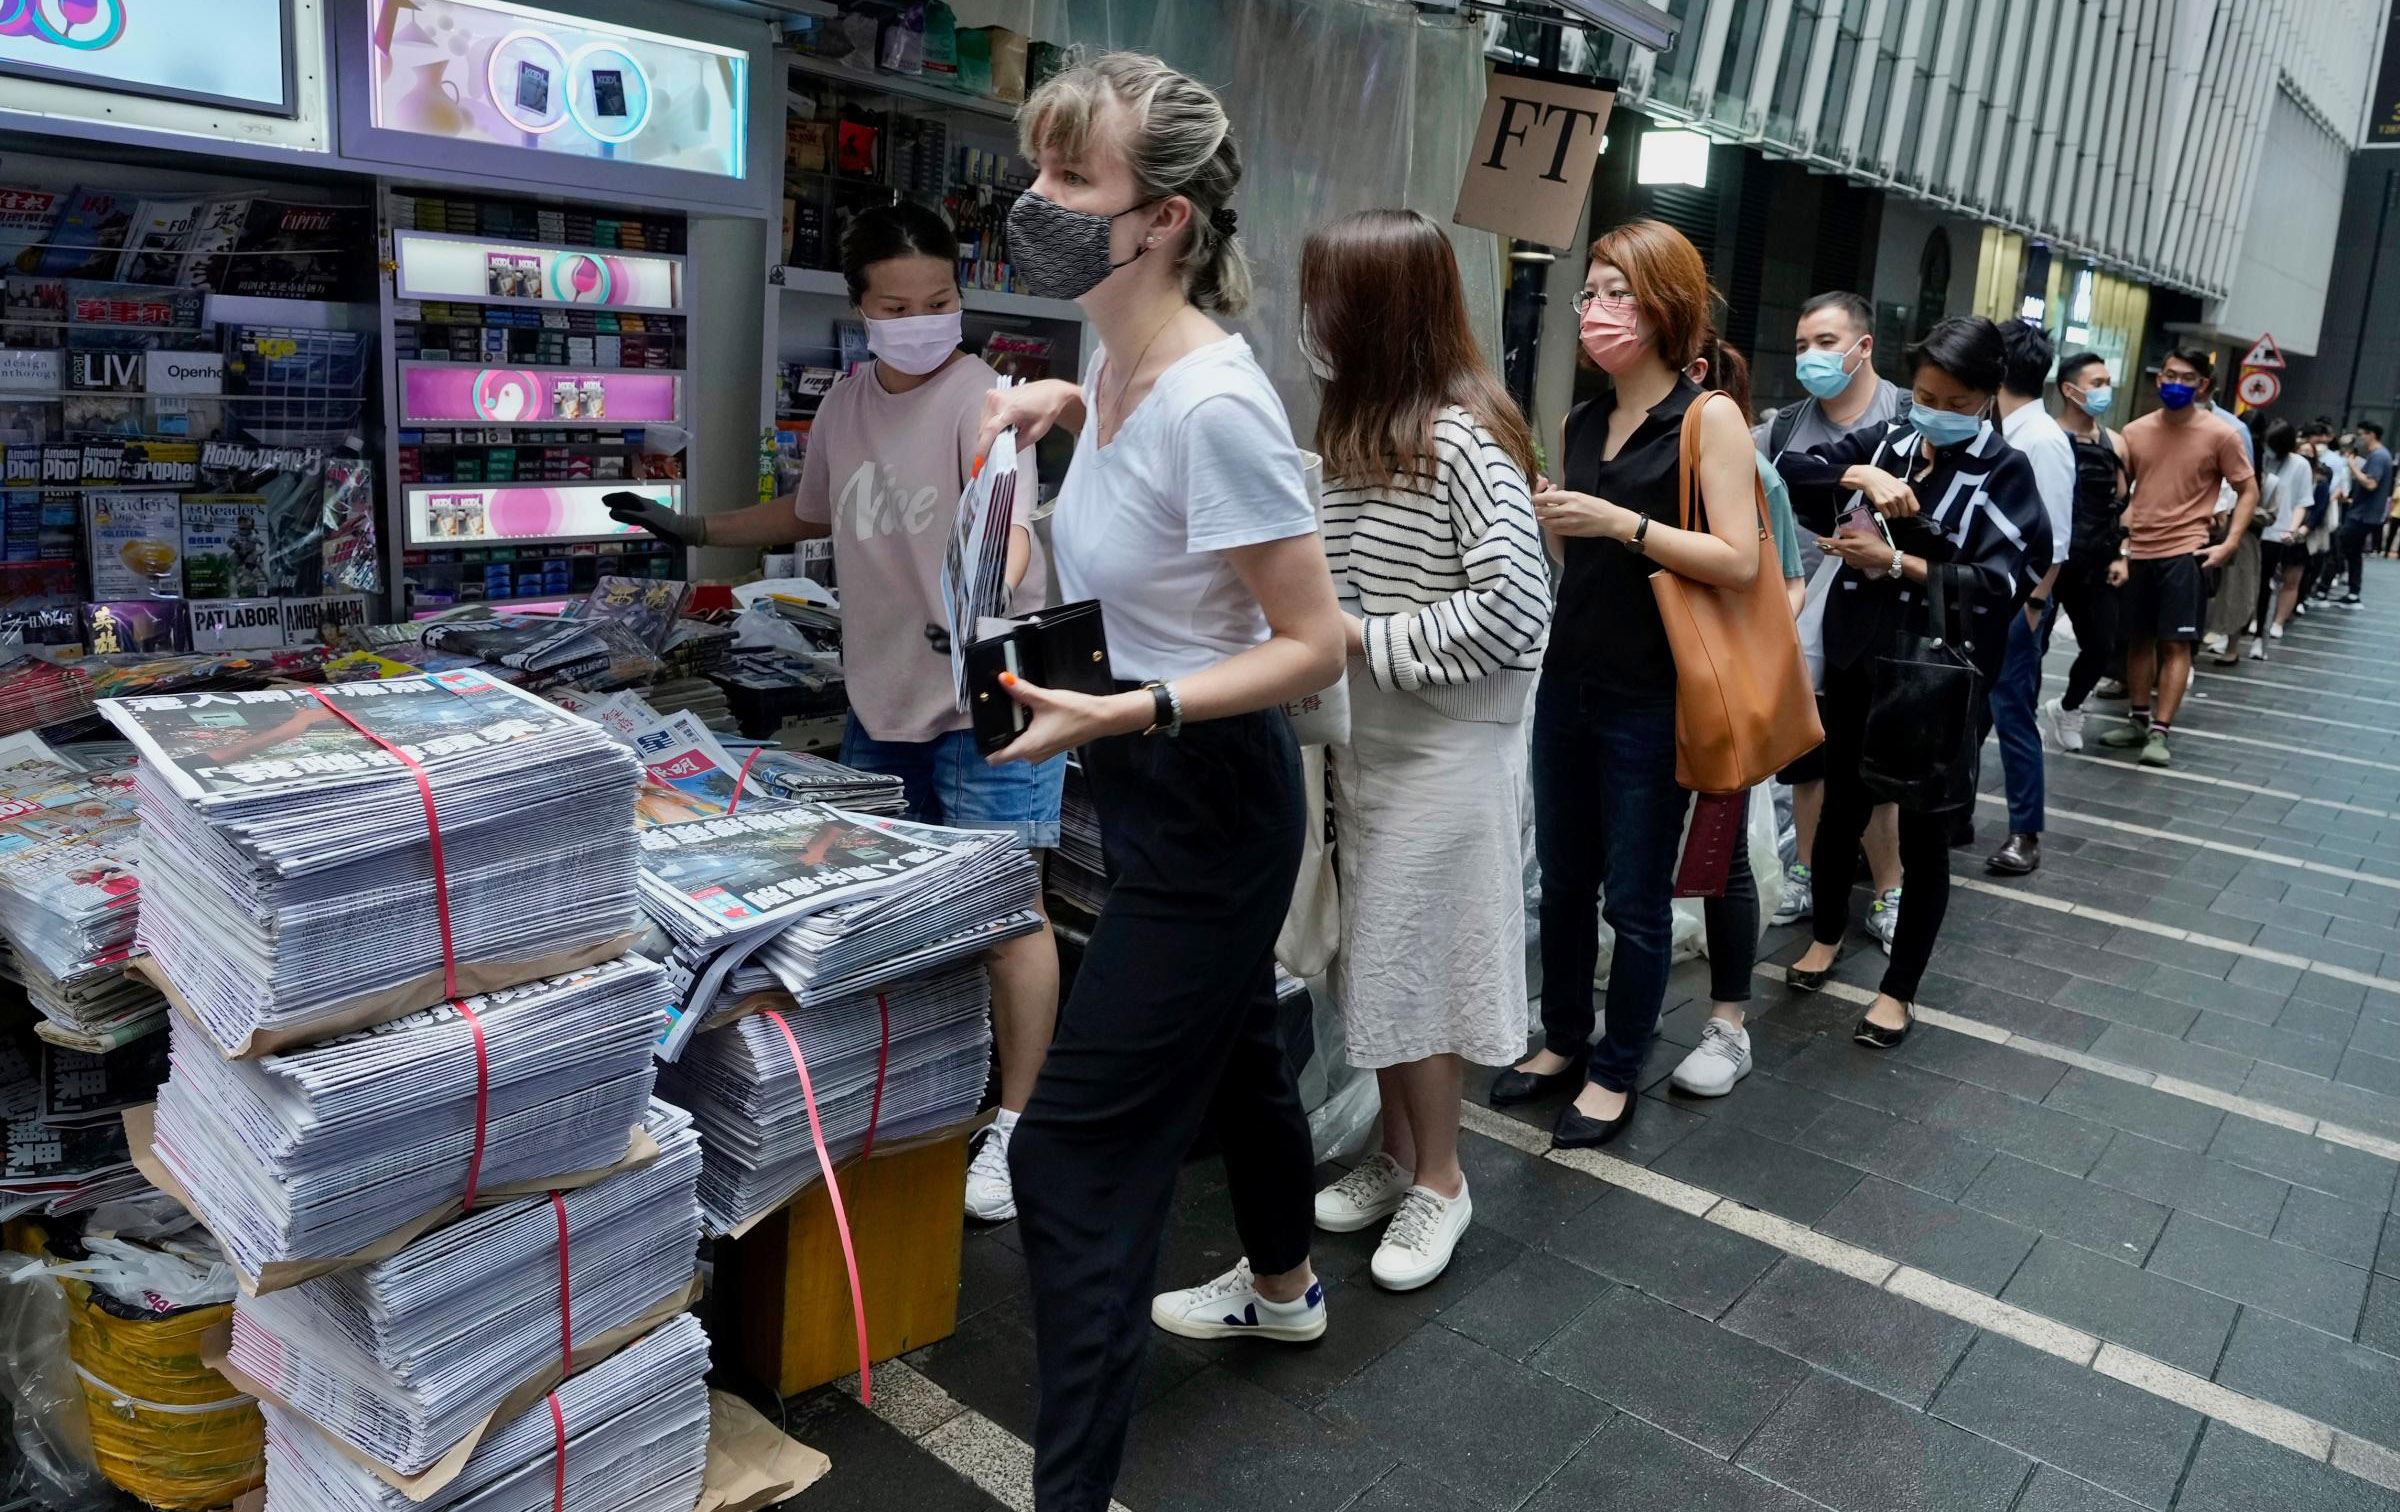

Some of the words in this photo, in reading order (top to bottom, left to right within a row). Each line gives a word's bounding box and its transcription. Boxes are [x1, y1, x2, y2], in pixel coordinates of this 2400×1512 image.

[1481, 96, 1599, 183] FT
[4, 359, 48, 370] design
[834, 461, 938, 541] Nice
[194, 606, 279, 631] PATLABOR
